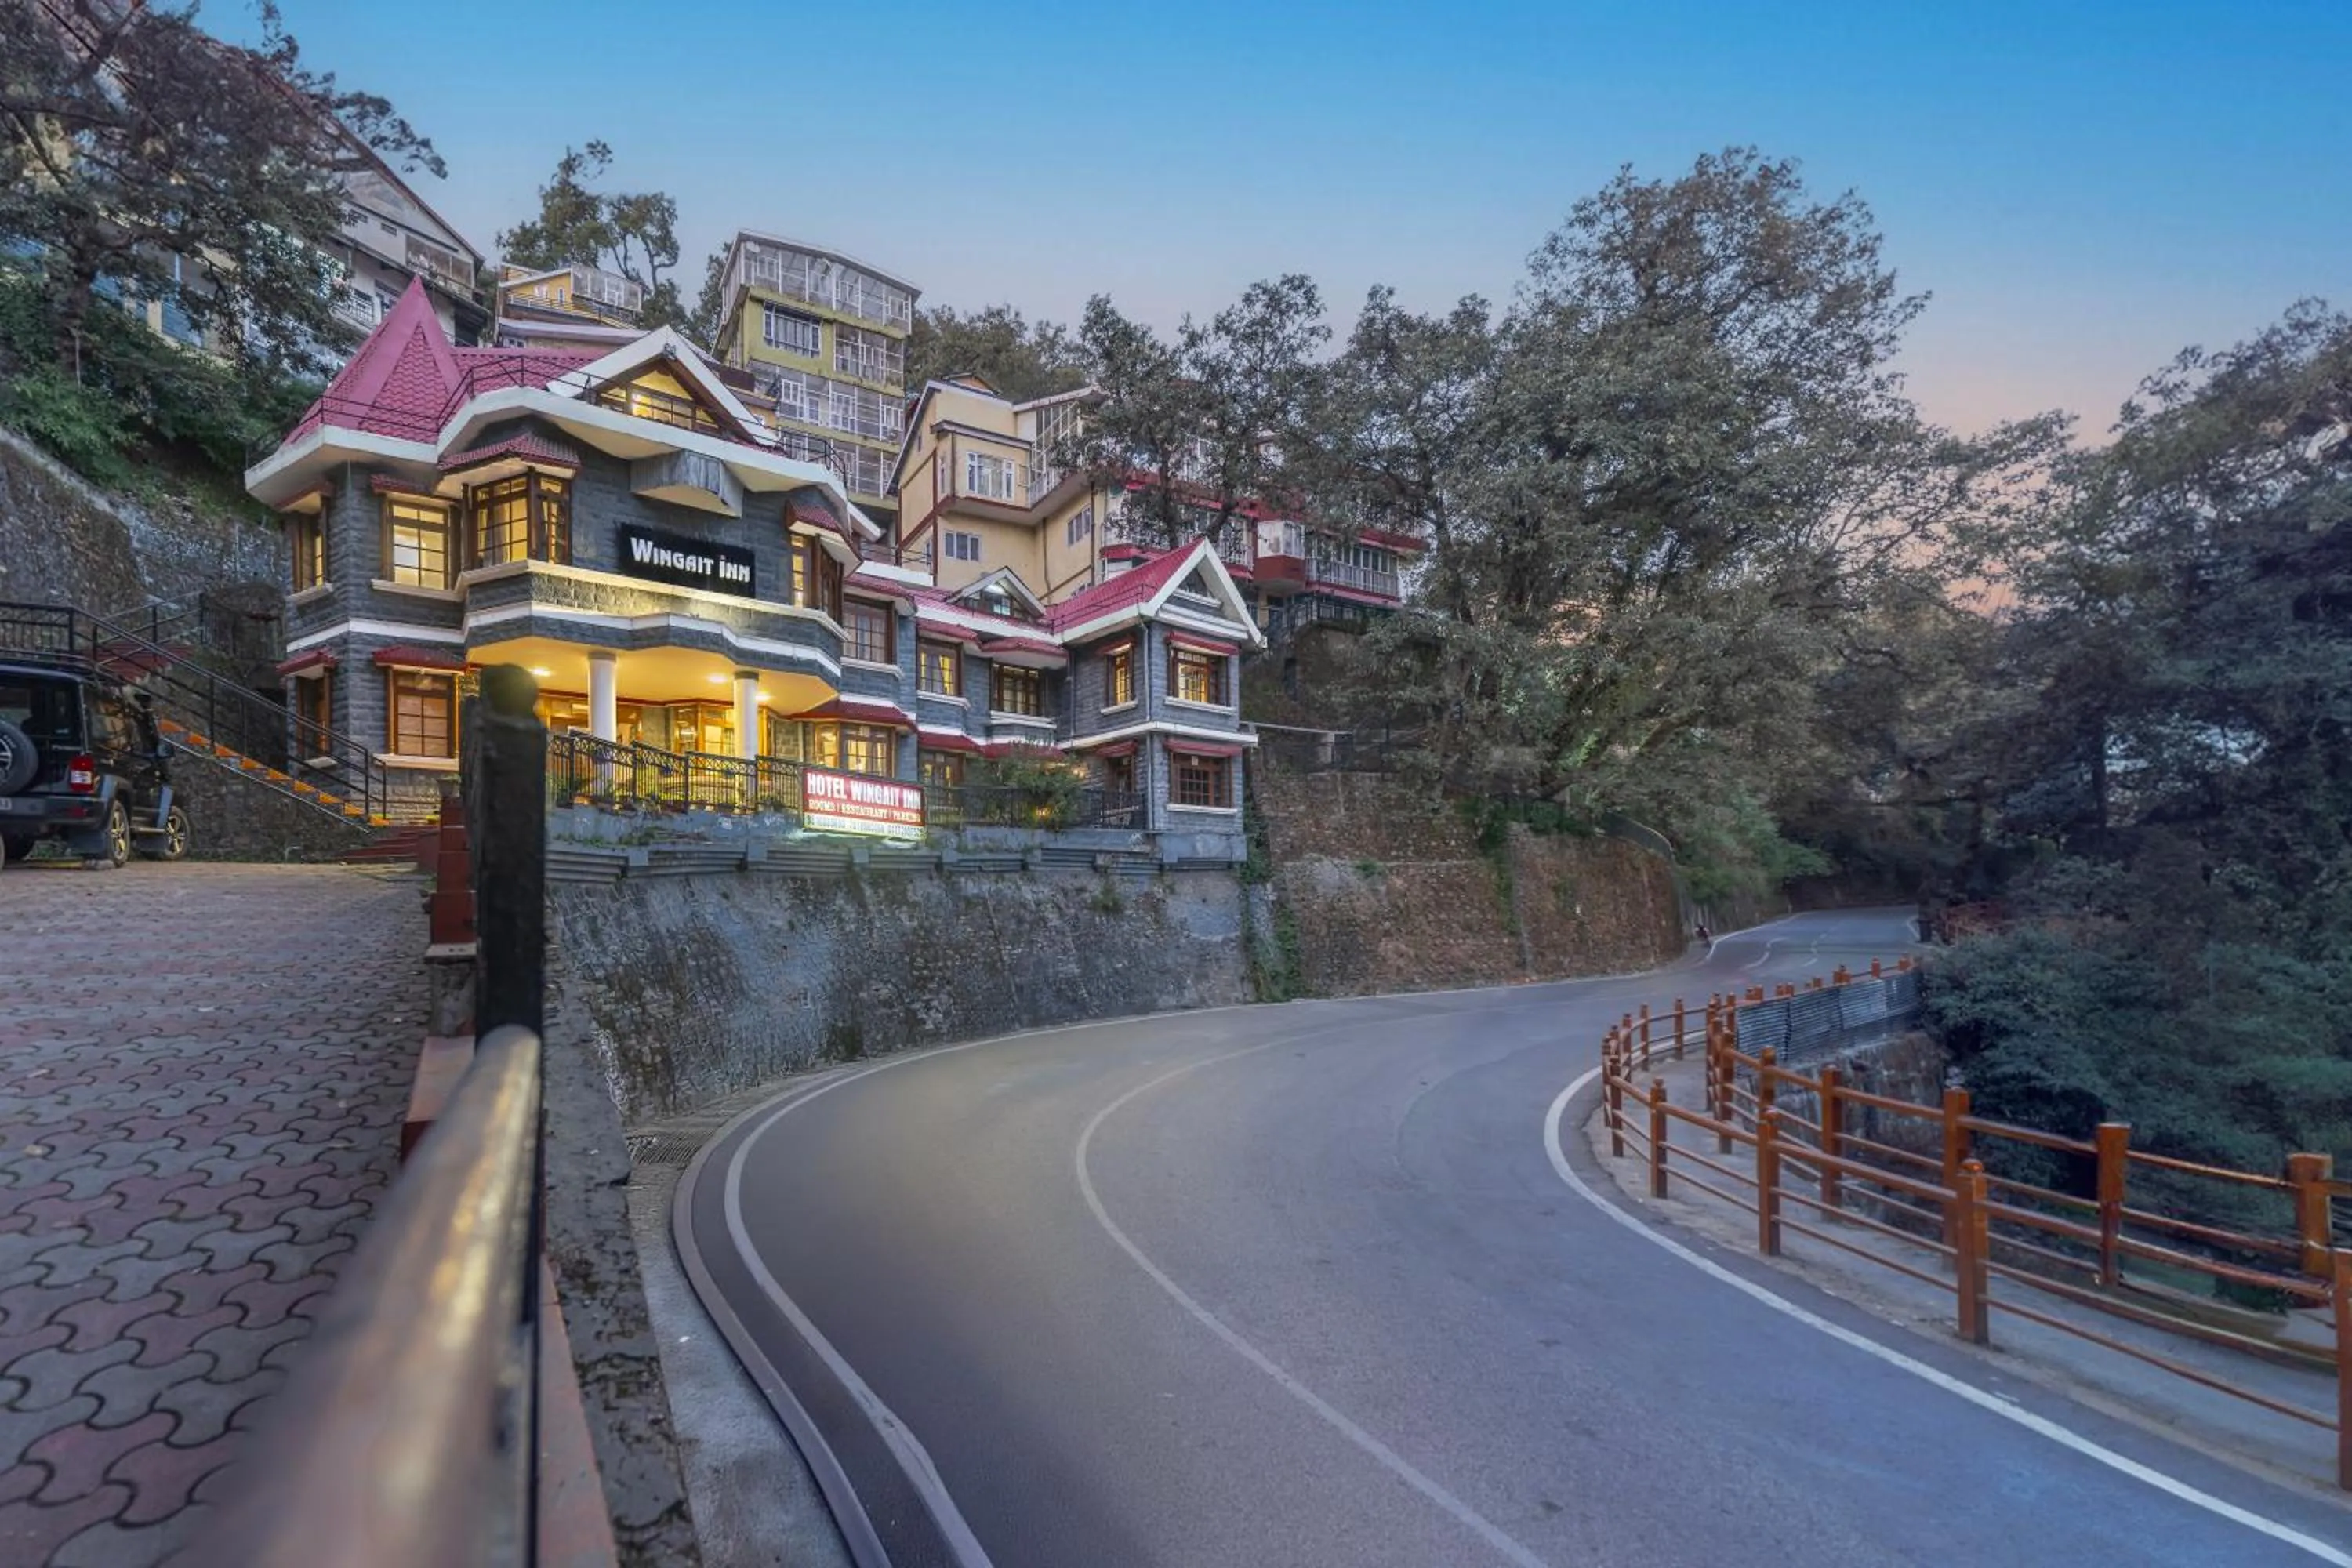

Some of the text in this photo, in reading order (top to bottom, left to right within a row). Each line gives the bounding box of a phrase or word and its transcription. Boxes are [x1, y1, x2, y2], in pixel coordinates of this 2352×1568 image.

[807, 772, 921, 810] HOTEL WINGAIT INN
